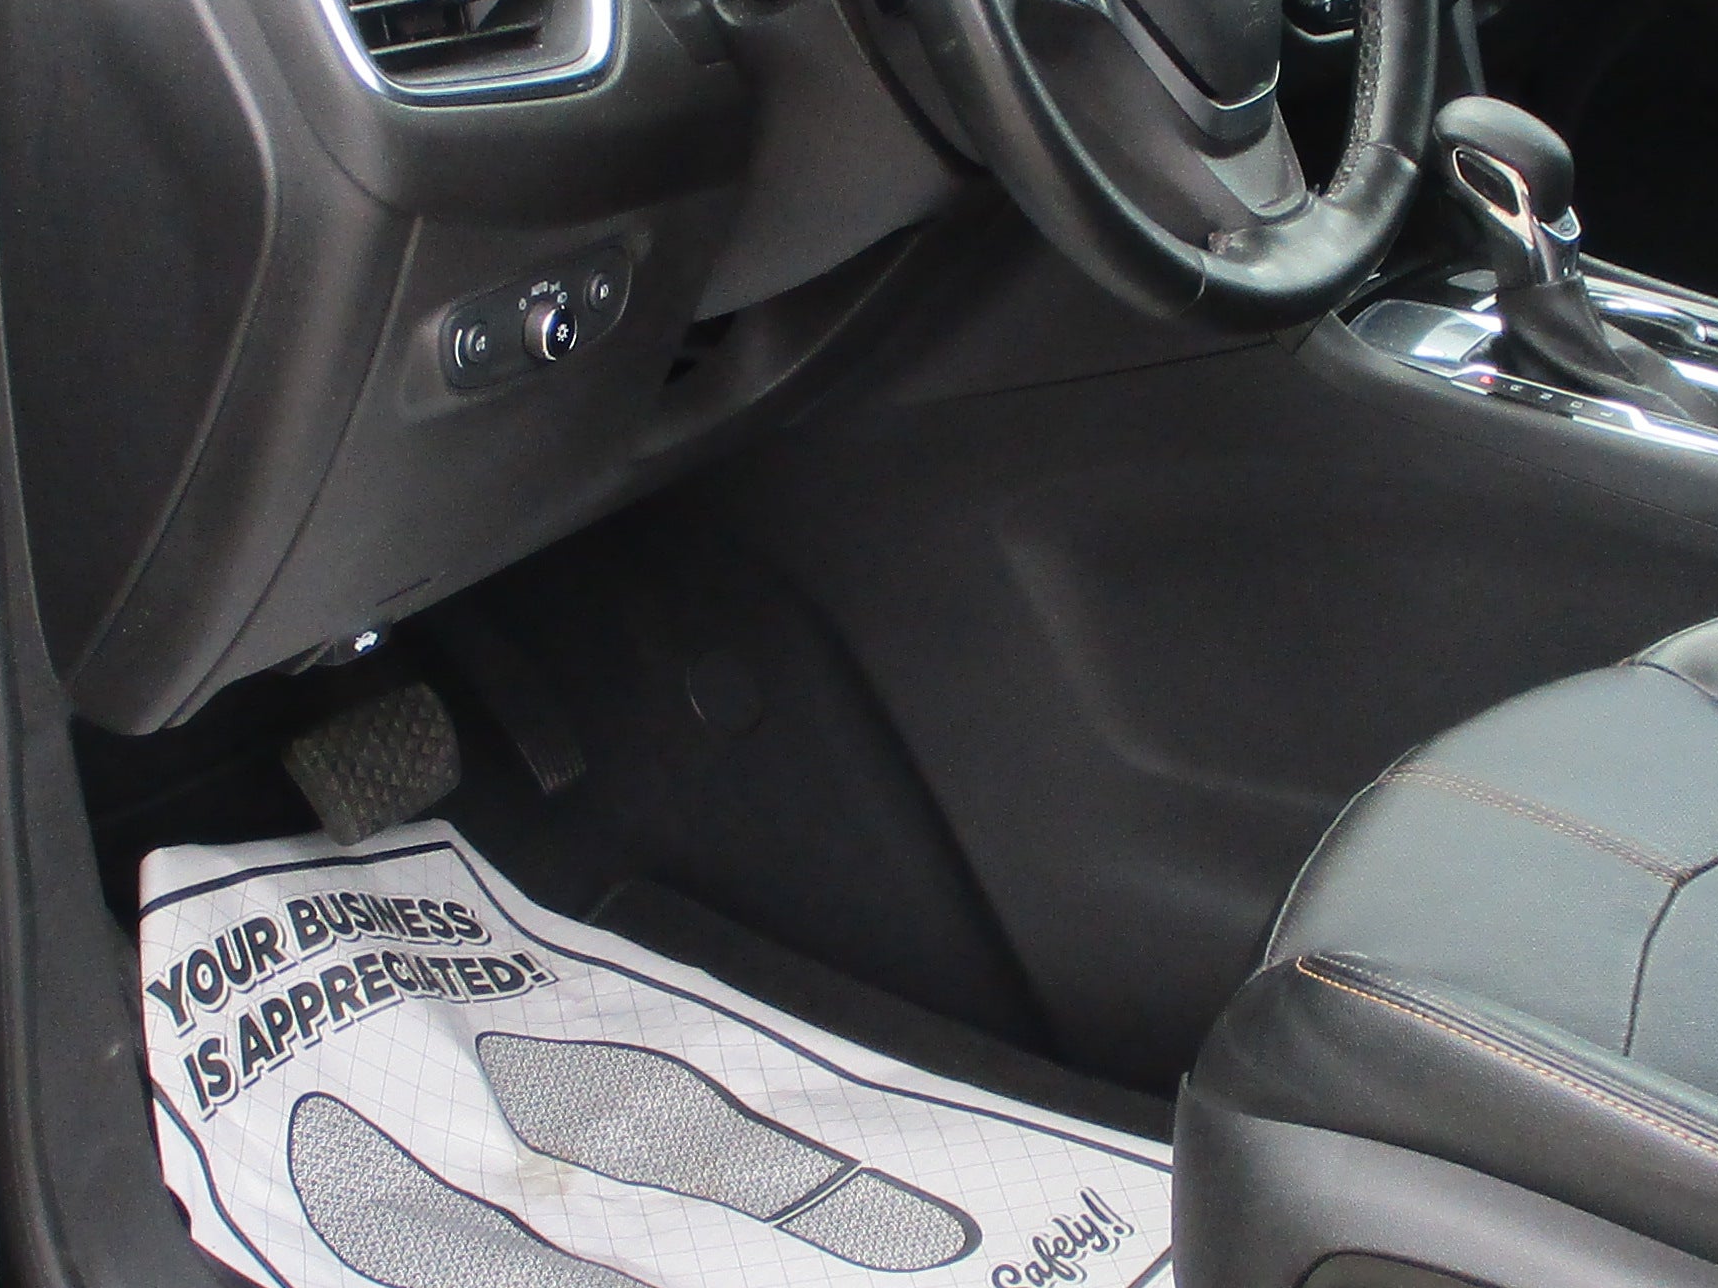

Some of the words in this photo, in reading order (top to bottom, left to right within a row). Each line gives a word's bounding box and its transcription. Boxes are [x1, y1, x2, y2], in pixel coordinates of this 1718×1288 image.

[145, 913, 296, 1035] YOUR
[285, 892, 491, 959] BUSINESS
[181, 1037, 238, 1118] IS
[237, 950, 557, 1087] APPRECIATED!
